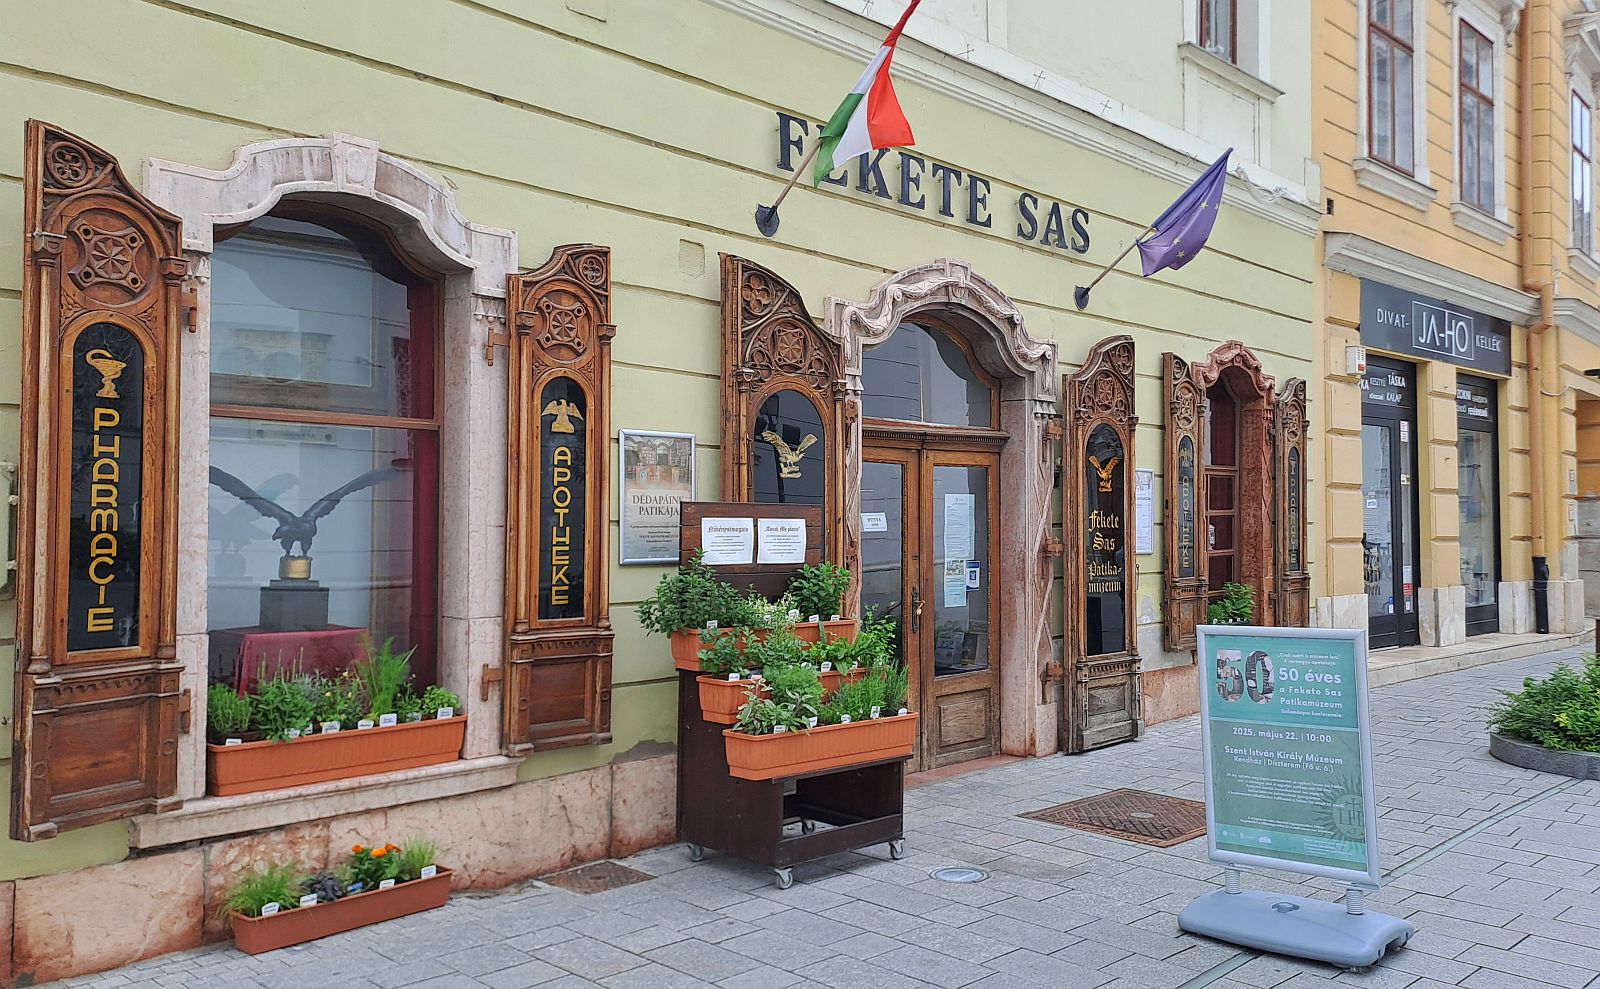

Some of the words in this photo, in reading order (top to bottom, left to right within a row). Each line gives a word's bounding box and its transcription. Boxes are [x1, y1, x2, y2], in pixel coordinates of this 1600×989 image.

[776, 112, 992, 228] FKETE
[1016, 192, 1090, 254] SAS
[1377, 308, 1410, 329] DIVAT-
[1418, 310, 1469, 354] JA-HO
[1475, 333, 1502, 353] KELLÉK
[1359, 378, 1370, 390] KA
[1387, 372, 1406, 388] TÁSKA
[1386, 392, 1402, 403] KALAP
[87, 407, 120, 633] PHARMACIE
[639, 504, 679, 518] PATIKÁJA
[1088, 509, 1120, 532] Fekete
[1290, 478, 1298, 563] PHARMACIE
[551, 446, 572, 605] APOTHEKE
[1182, 475, 1190, 568] APOTHEKE
[1092, 532, 1116, 553] Sas
[1088, 561, 1122, 577] Patika-
[1216, 649, 1275, 704] 50
[1279, 667, 1298, 681] 50
[1304, 669, 1341, 684] éves
[1289, 685, 1321, 696] Fekete
[1324, 688, 1342, 697] Sas
[1280, 698, 1343, 709] Patikamúzeum
[1232, 727, 1256, 737] 2025.
[1258, 730, 1284, 741] május
[1286, 732, 1298, 740] 22.
[1306, 733, 1332, 743] 10:00
[1224, 746, 1248, 755] Szent
[1249, 748, 1274, 758] István
[1276, 750, 1304, 763] Király
[1306, 753, 1343, 765] Múzeum
[1234, 756, 1262, 765] Rendház
[1302, 762, 1314, 771] (Fő
[1324, 764, 1334, 774] 6.)
